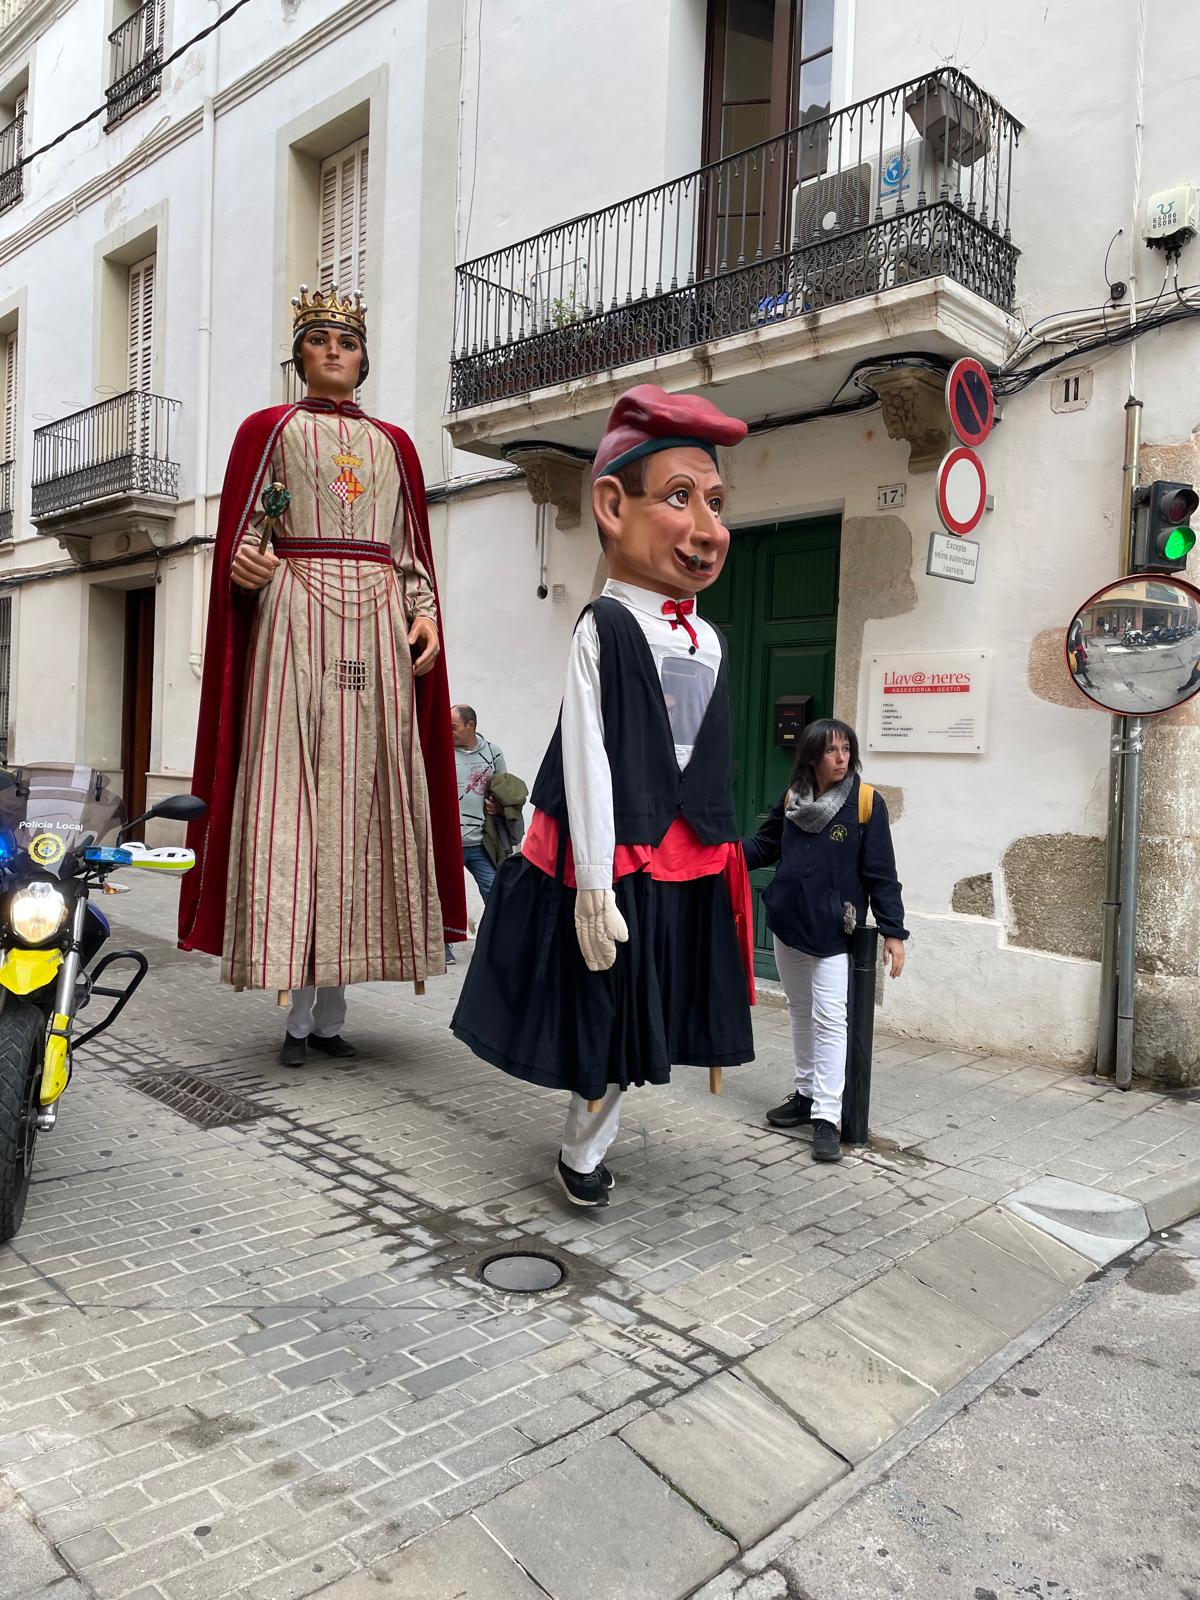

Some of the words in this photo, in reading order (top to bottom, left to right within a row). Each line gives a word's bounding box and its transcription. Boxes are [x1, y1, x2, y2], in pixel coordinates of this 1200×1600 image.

[1063, 376, 1080, 404] 11
[882, 490, 899, 504] 17
[19, 820, 53, 830] Policia
[56, 821, 84, 832] Local
